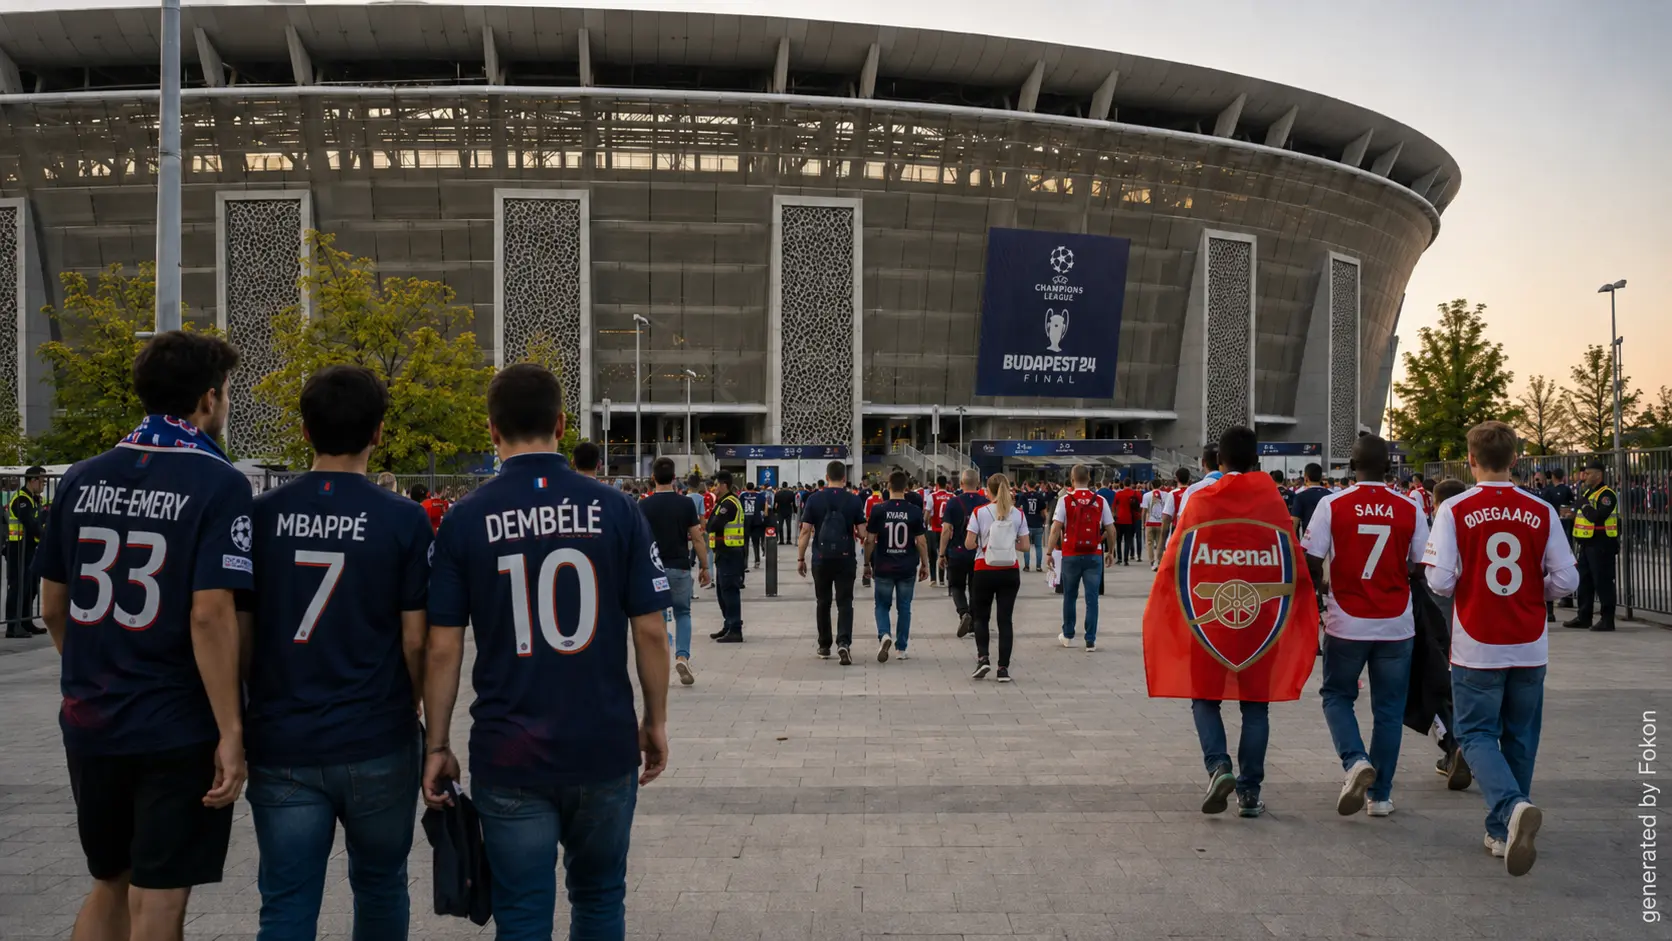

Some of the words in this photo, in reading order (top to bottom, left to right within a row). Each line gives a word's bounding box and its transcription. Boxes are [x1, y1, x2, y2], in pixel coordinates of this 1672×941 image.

[1035, 284, 1083, 294] CHAMPIONS
[1043, 293, 1074, 301] LEAGUE
[1002, 354, 1079, 372] BUDAPEST
[1079, 357, 1097, 372] 24
[1024, 374, 1074, 384] FINAL
[73, 480, 190, 521] ZAÏRE-EMERY
[1354, 503, 1394, 518] SAKA
[276, 512, 368, 541] MBAPPÉ
[485, 498, 602, 543] DEMBÉLÉ
[1464, 505, 1541, 530] ØDEGAARD
[884, 521, 909, 549] 10
[1194, 543, 1279, 567] Arsenal
[1357, 524, 1391, 580] 7
[1485, 532, 1522, 596] 8
[69, 526, 167, 631] 33
[293, 549, 345, 643] 7
[497, 547, 599, 657] 10
